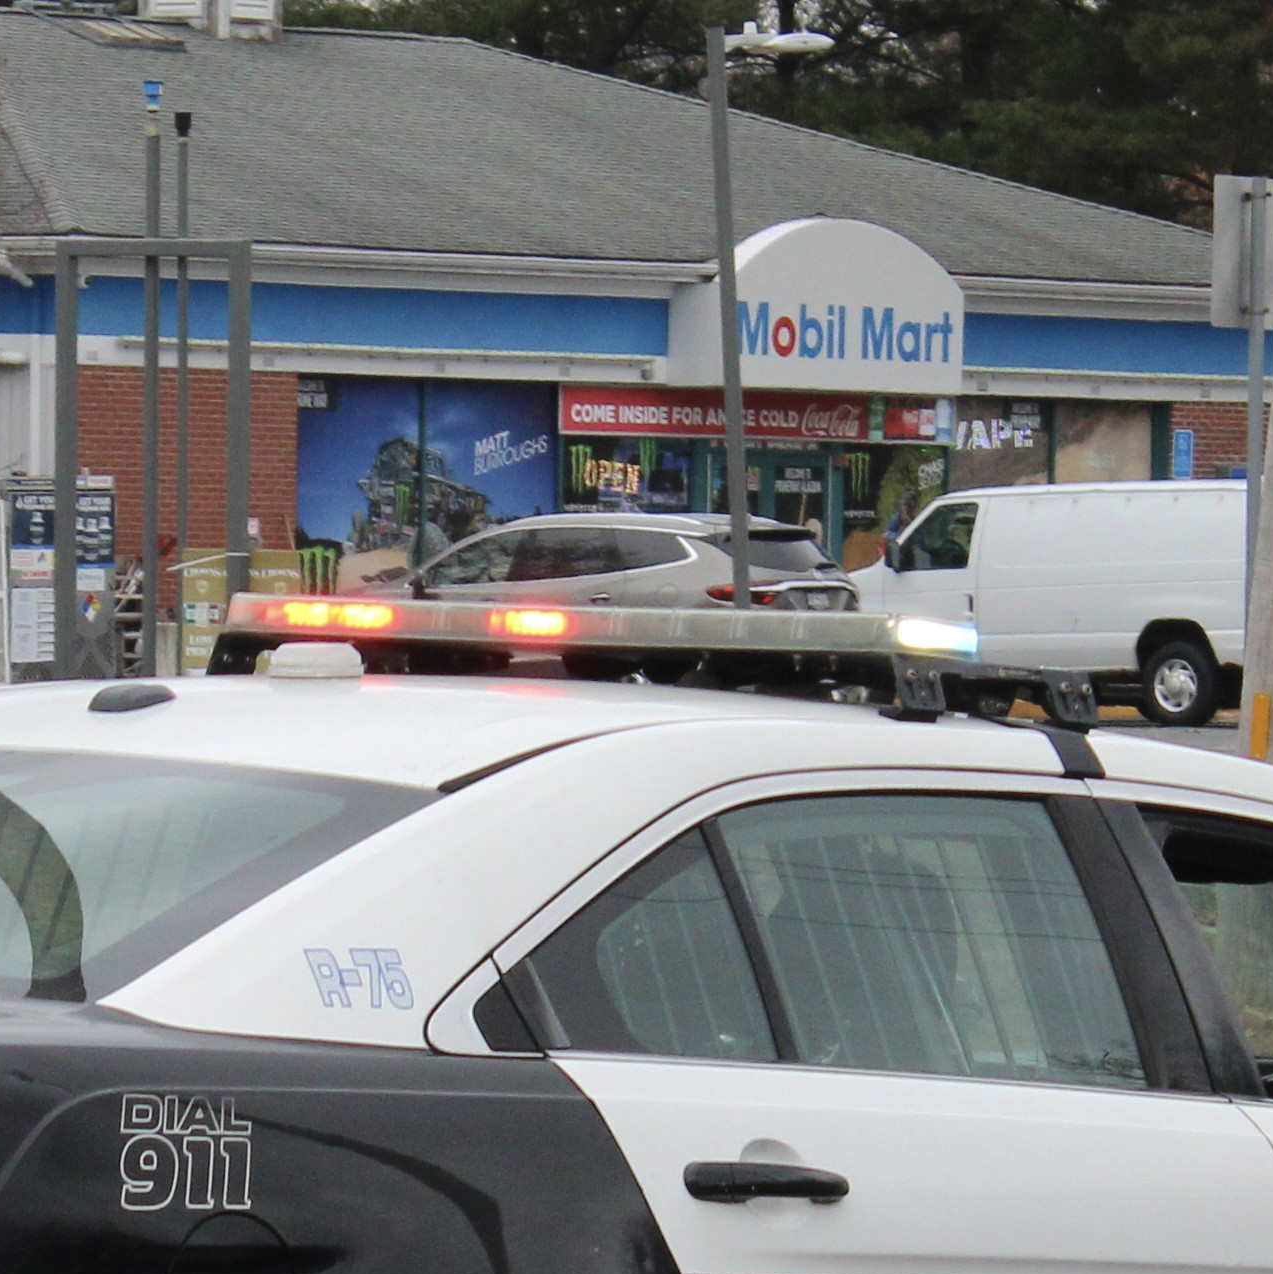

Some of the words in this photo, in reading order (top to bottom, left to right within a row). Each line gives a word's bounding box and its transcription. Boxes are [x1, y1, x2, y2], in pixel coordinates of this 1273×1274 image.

[737, 300, 847, 360] Mobil
[861, 306, 954, 364] Mart
[571, 403, 615, 424] COME
[618, 404, 669, 425] INSIDE
[672, 407, 702, 426] FOR
[759, 409, 799, 428] COLD
[474, 430, 510, 456] MATT
[583, 459, 641, 495] OPEN
[303, 947, 415, 1010] R-75
[119, 1093, 252, 1136] DIAL
[119, 1133, 252, 1212] 911
